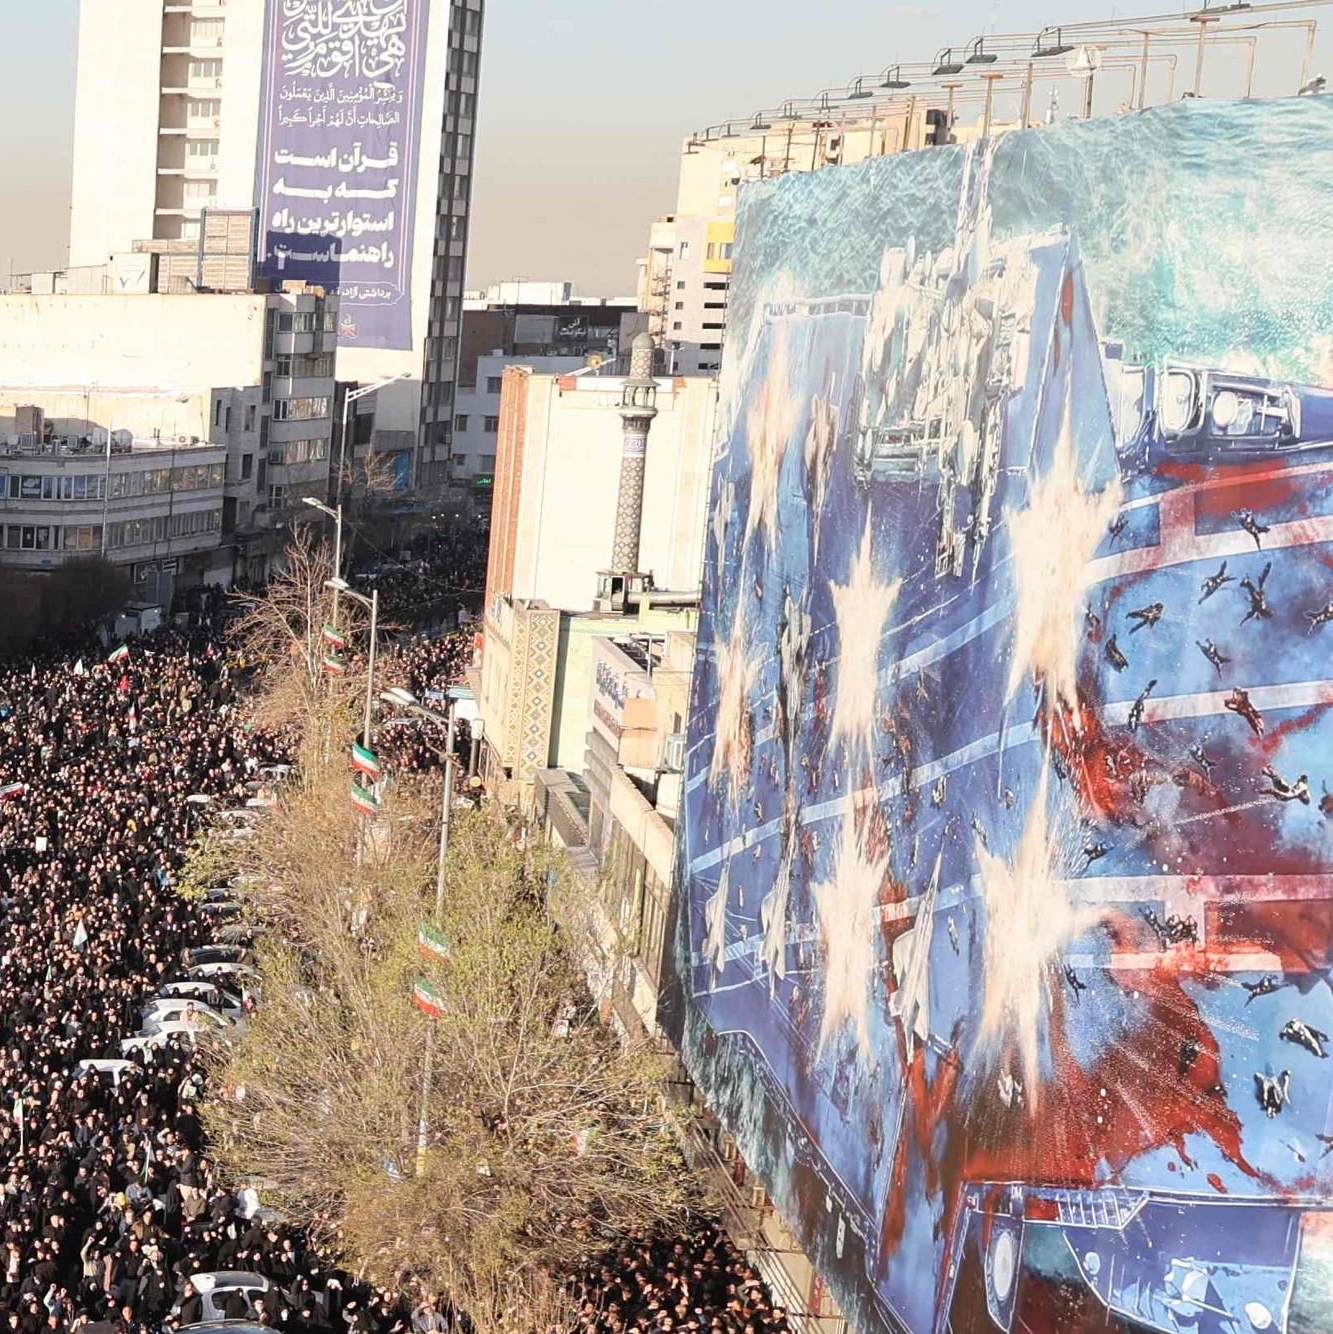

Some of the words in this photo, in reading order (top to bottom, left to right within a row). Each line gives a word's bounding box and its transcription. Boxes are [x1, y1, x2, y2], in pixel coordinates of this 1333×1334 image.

[274, 147, 337, 168] است
[338, 141, 399, 173] قرآن
[273, 177, 333, 204] به
[335, 178, 399, 199] که
[272, 208, 295, 233] راه
[297, 210, 395, 237] استوارترین
